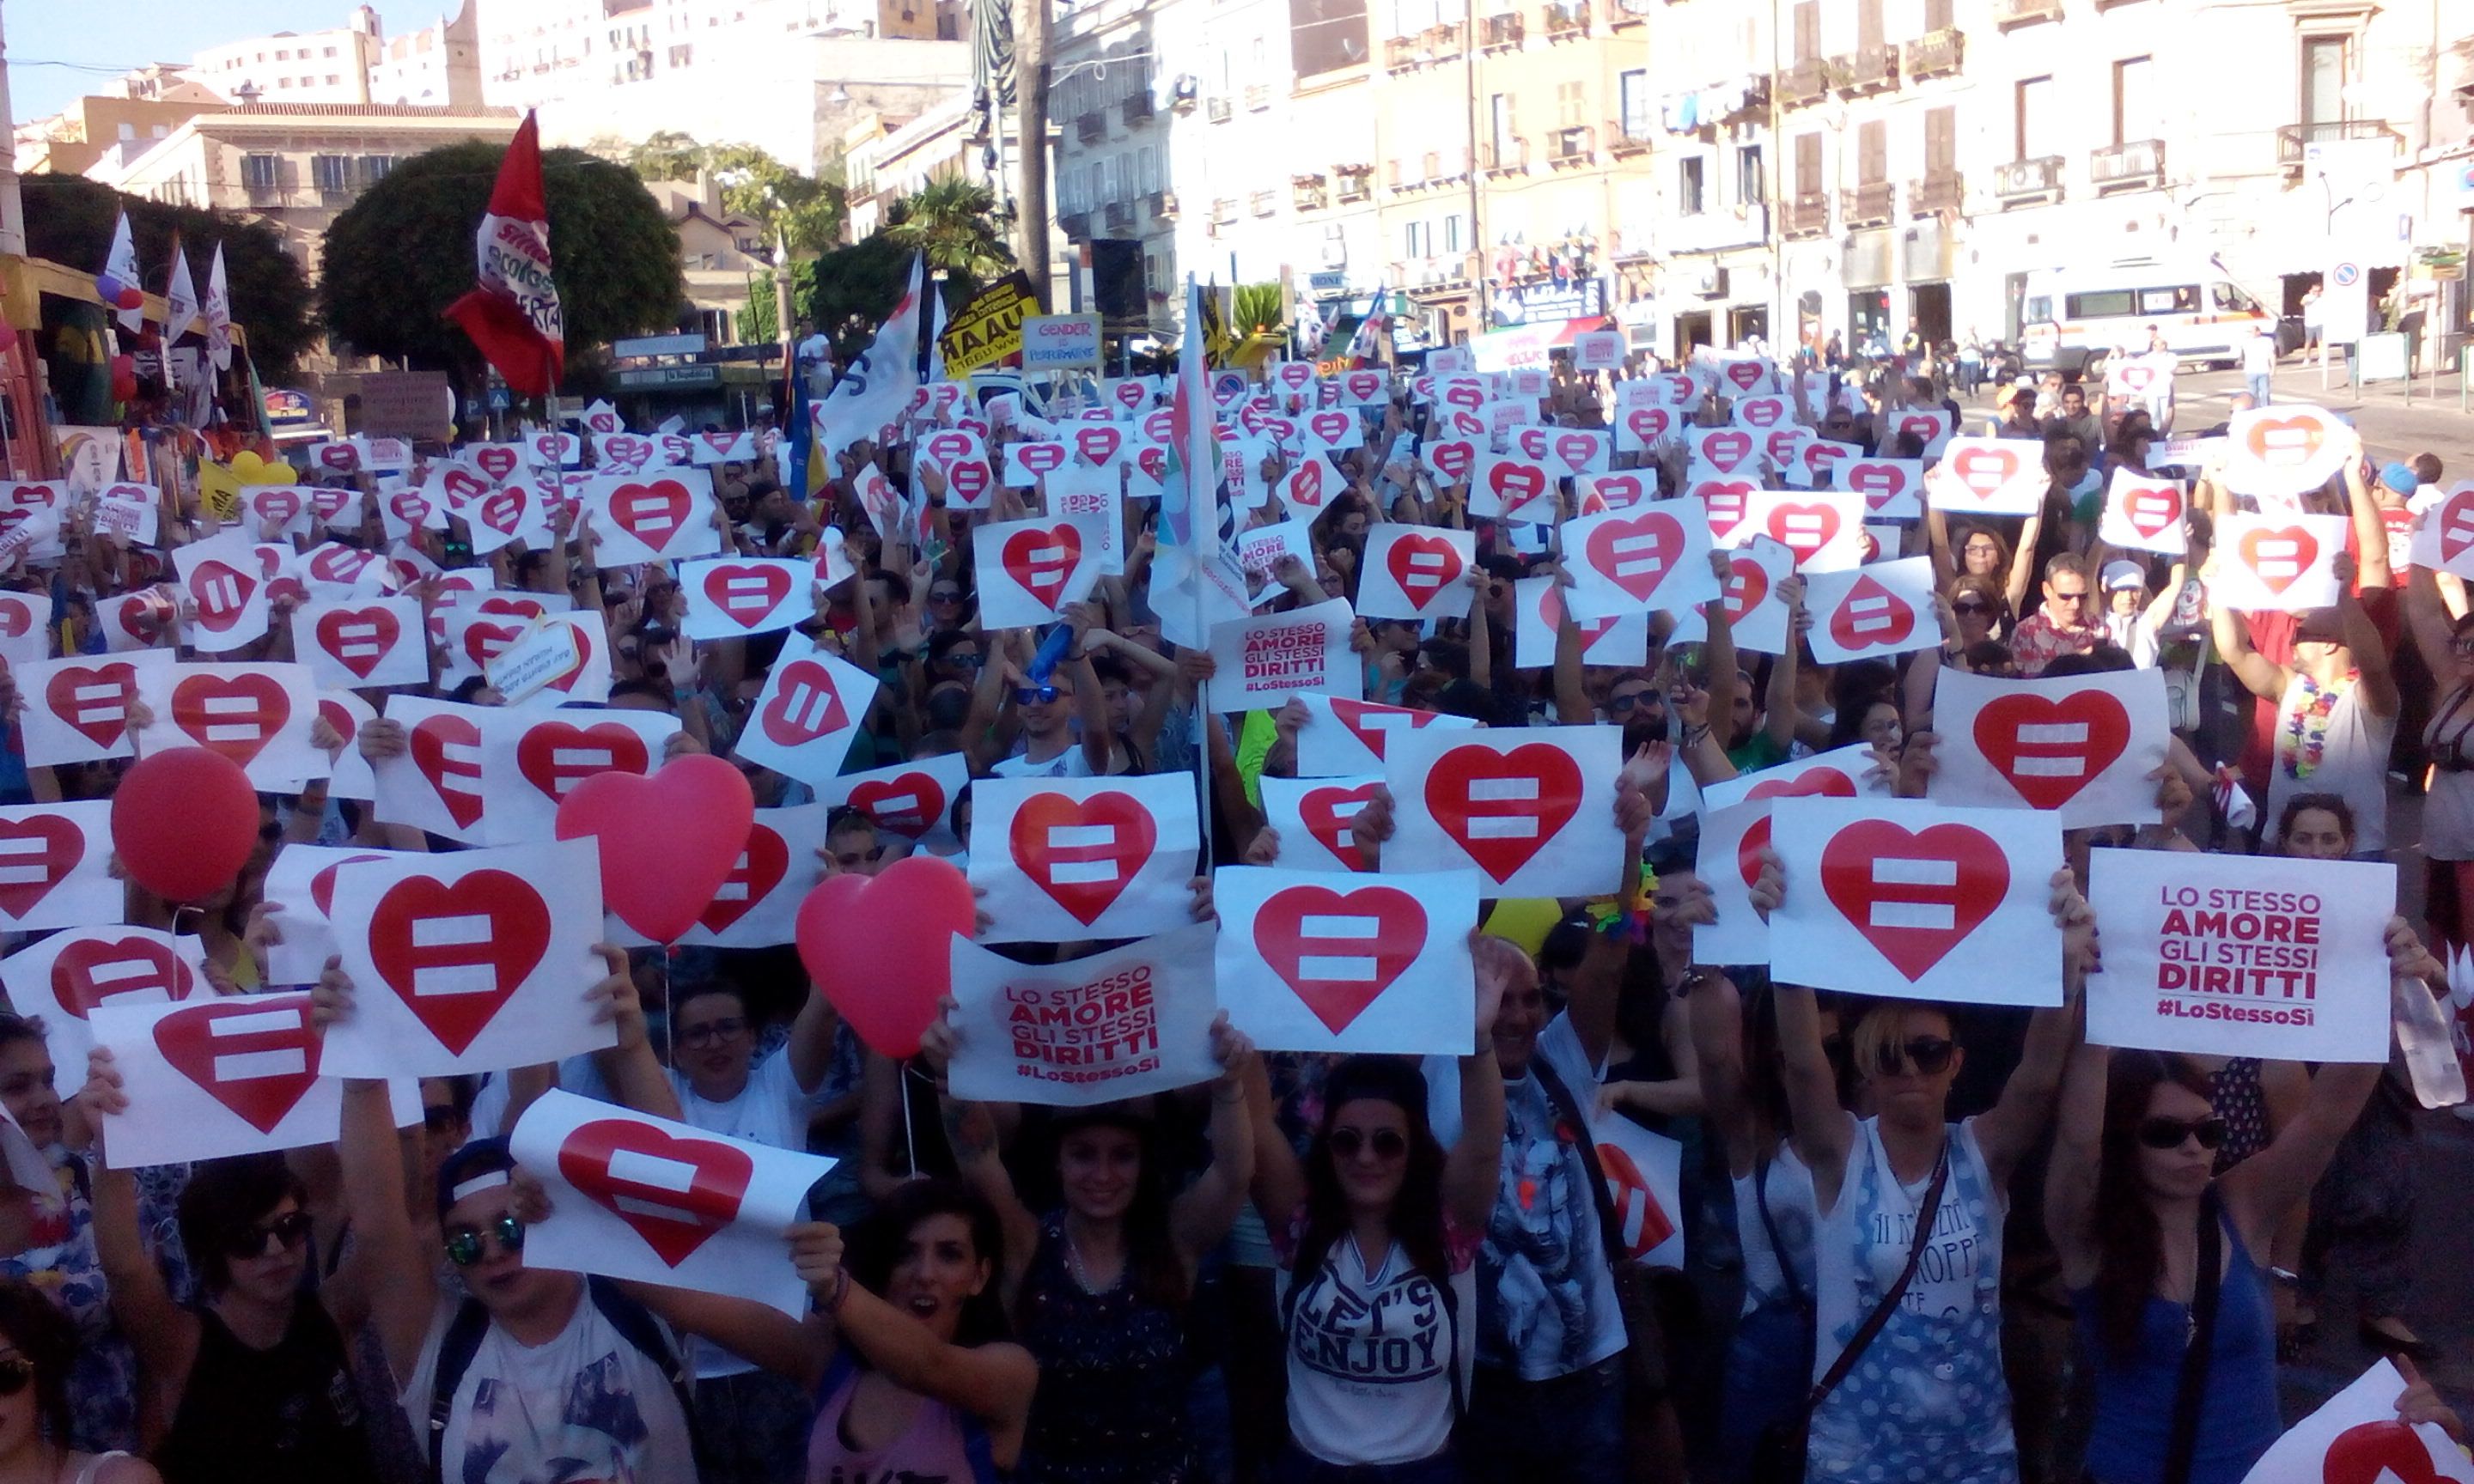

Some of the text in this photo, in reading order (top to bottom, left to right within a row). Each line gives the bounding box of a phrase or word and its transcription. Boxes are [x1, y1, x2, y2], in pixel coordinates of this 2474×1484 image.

[1039, 322, 1093, 337] GENDER
[1245, 542, 1285, 563] MORE
[1246, 622, 1325, 641] LO STESSO
[1246, 633, 1325, 653] AMORE
[1245, 657, 1325, 678] DIRITTI
[1246, 645, 1325, 664] GLI STESSI
[2161, 885, 2321, 915] LO STESSO
[2160, 909, 2320, 945] AMORE
[2160, 940, 2318, 970] GLI STESSI
[1005, 965, 1152, 1006] LO STESSO
[2158, 962, 2317, 1000] DIRITTI
[1008, 981, 1154, 1027] AMORE
[1011, 1006, 1156, 1045] GLI STESSI
[1013, 1025, 1159, 1066] DIRITTI
[1300, 1268, 1438, 1337] LET'S
[1295, 1314, 1440, 1374] ENJOY
